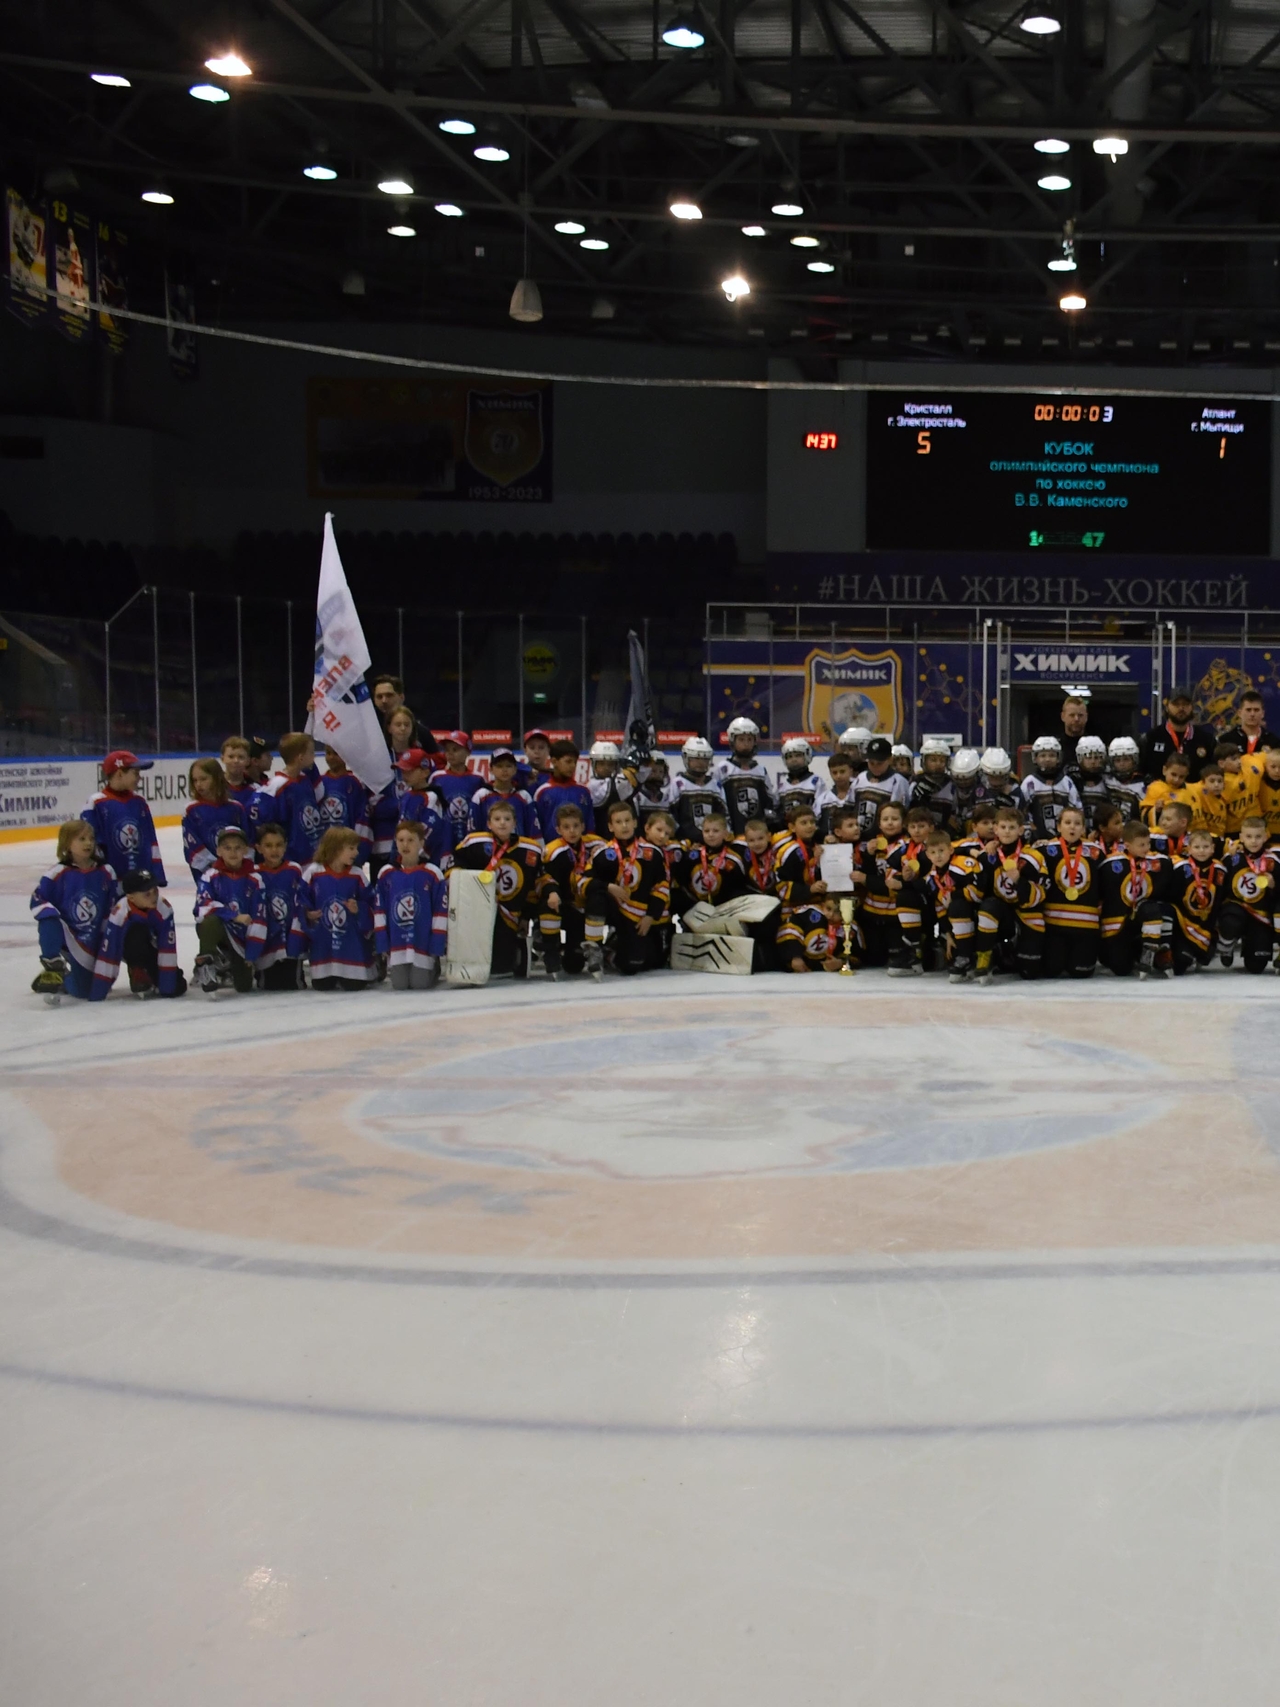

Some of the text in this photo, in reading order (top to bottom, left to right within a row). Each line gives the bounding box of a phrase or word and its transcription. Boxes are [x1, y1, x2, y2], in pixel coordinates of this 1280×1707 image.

[904, 403, 953, 414] Кристалл
[1202, 408, 1237, 419] Атлант
[897, 416, 967, 428] Электросталь
[1200, 422, 1245, 433] Мытищи
[917, 431, 932, 454] 5
[1044, 442, 1095, 456] КУБОК
[1219, 437, 1227, 459] 1
[989, 459, 1160, 474] олимпийского чемпиона
[1035, 478, 1107, 490] по хоккею
[1014, 493, 1128, 508] В.В. Каменского
[818, 573, 948, 601] #НАША
[1013, 653, 1131, 673] ХИМИК
[821, 668, 888, 680] ХИМИК
[250, 806, 260, 820] 5
